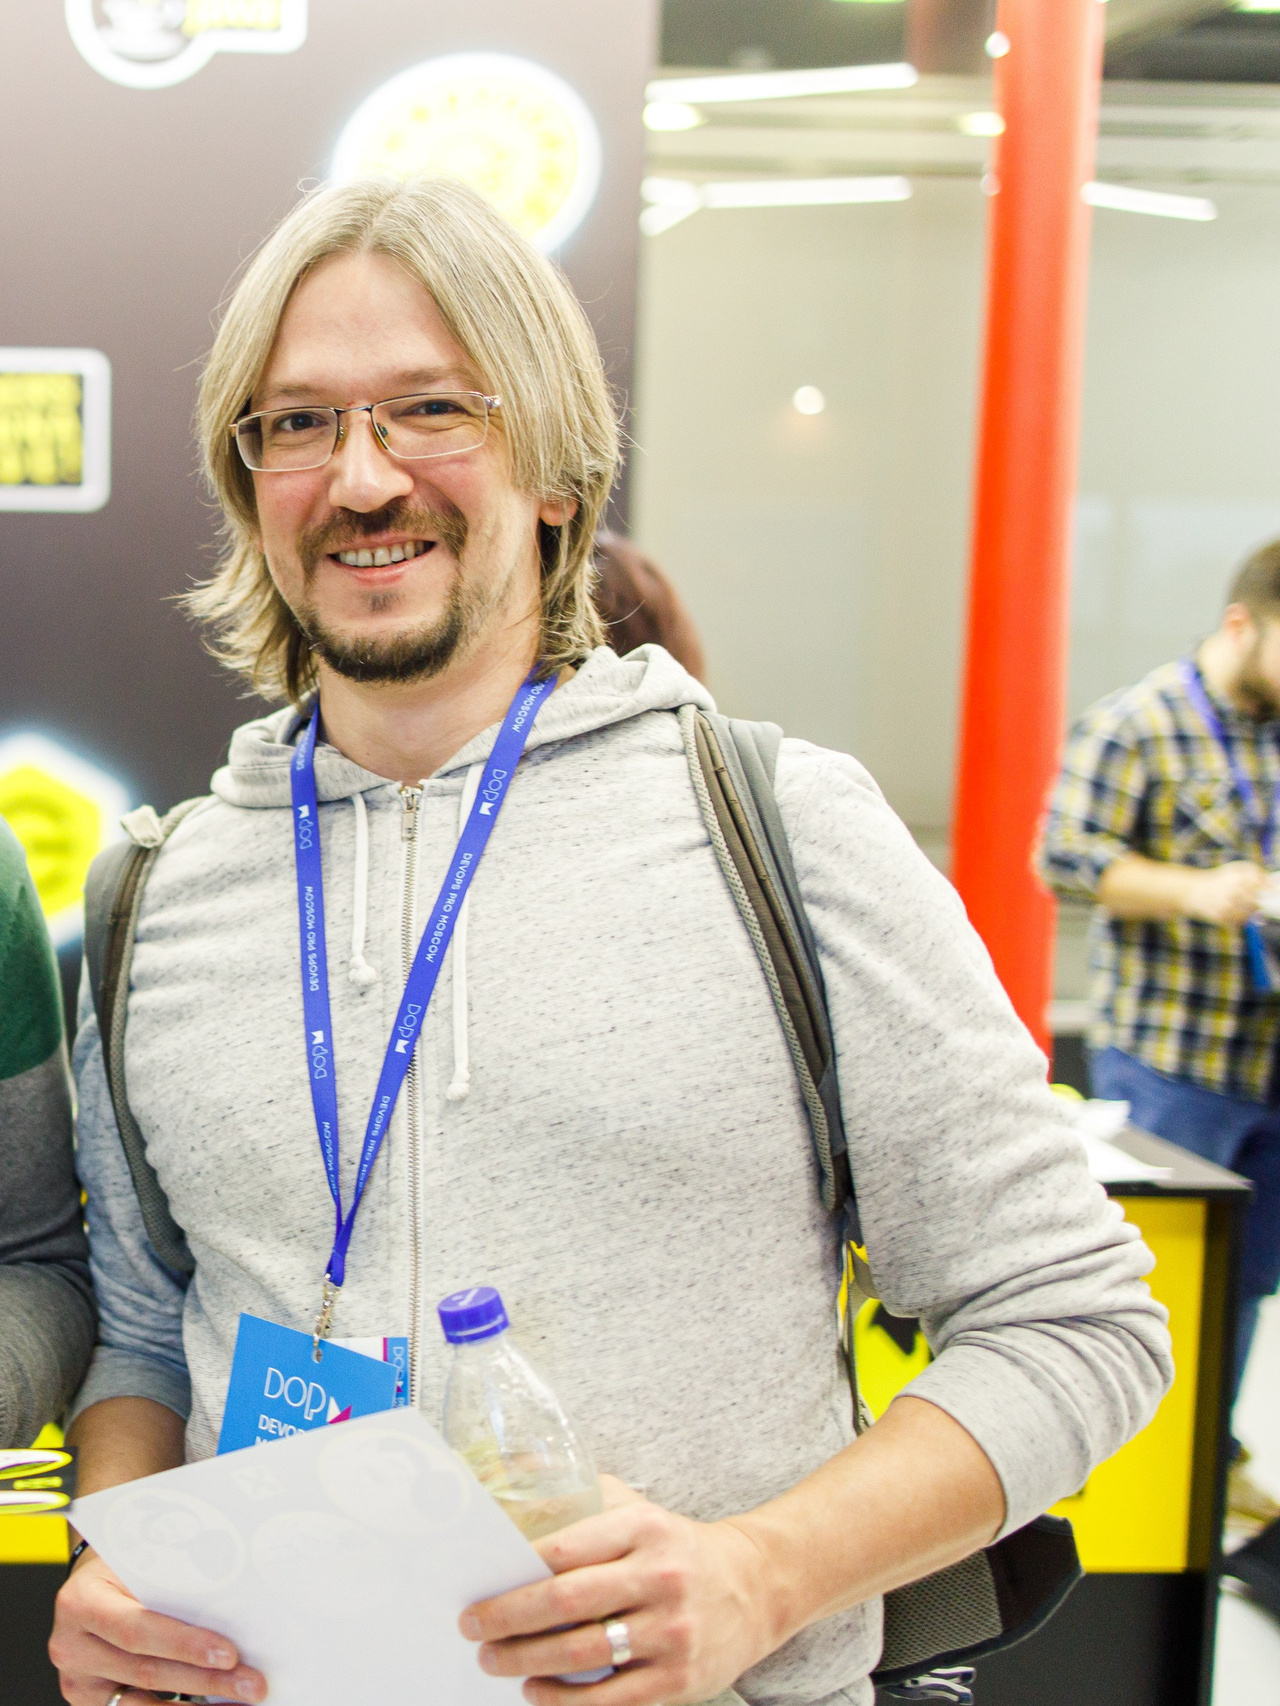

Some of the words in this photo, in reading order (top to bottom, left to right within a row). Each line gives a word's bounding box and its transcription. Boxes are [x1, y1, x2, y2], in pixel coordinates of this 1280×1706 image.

[511, 694, 537, 733] MOSCOW
[482, 769, 508, 801] DOP
[455, 853, 473, 891] DEVOPS
[305, 886, 314, 929] MOSCOW
[445, 891, 458, 912] PRO
[307, 931, 317, 950] PRO
[426, 915, 449, 963] MOSCOW
[309, 951, 320, 992] DEVOPS
[398, 1003, 421, 1039] DOP
[371, 1095, 391, 1137] DEVOPS
[365, 1139, 377, 1161] PRO
[264, 1367, 327, 1421] DOP
